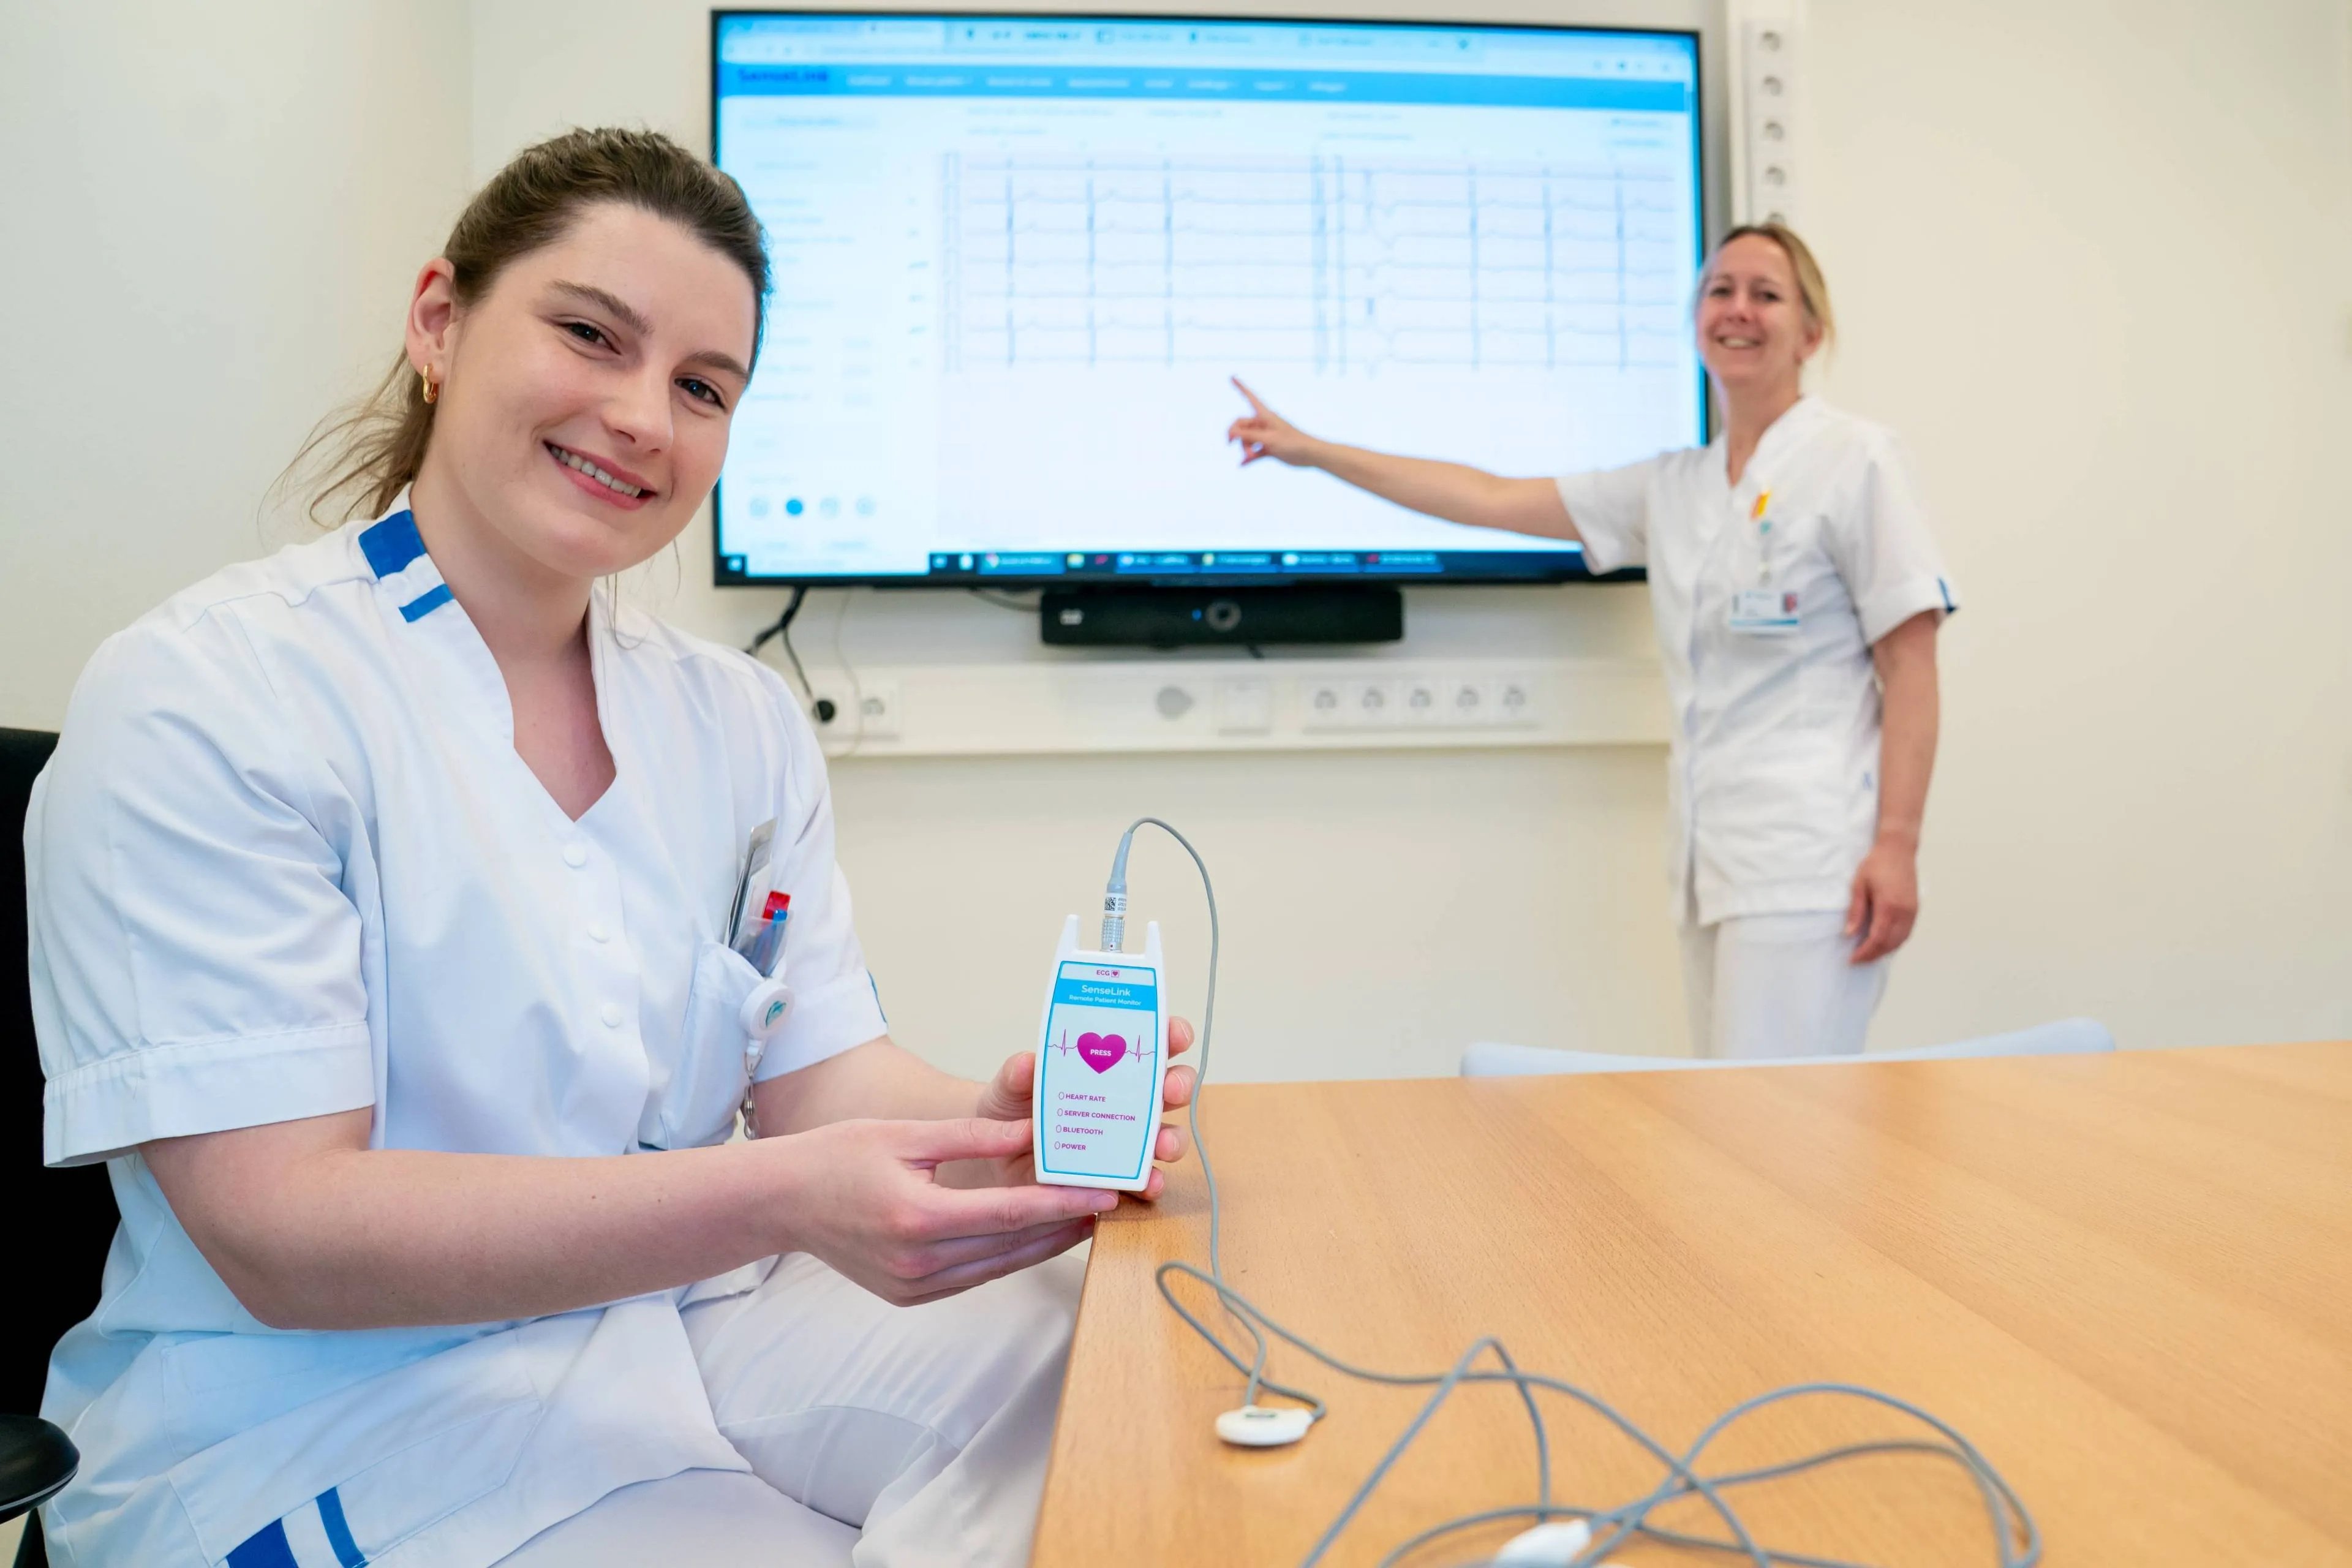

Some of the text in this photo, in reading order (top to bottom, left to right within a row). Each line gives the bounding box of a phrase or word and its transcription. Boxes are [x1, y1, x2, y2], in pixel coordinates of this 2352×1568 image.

[1082, 985, 1131, 996] SenseLink
[1091, 1112, 1135, 1121] CONNECTION
[1063, 1126, 1103, 1135] BLUETOOTH
